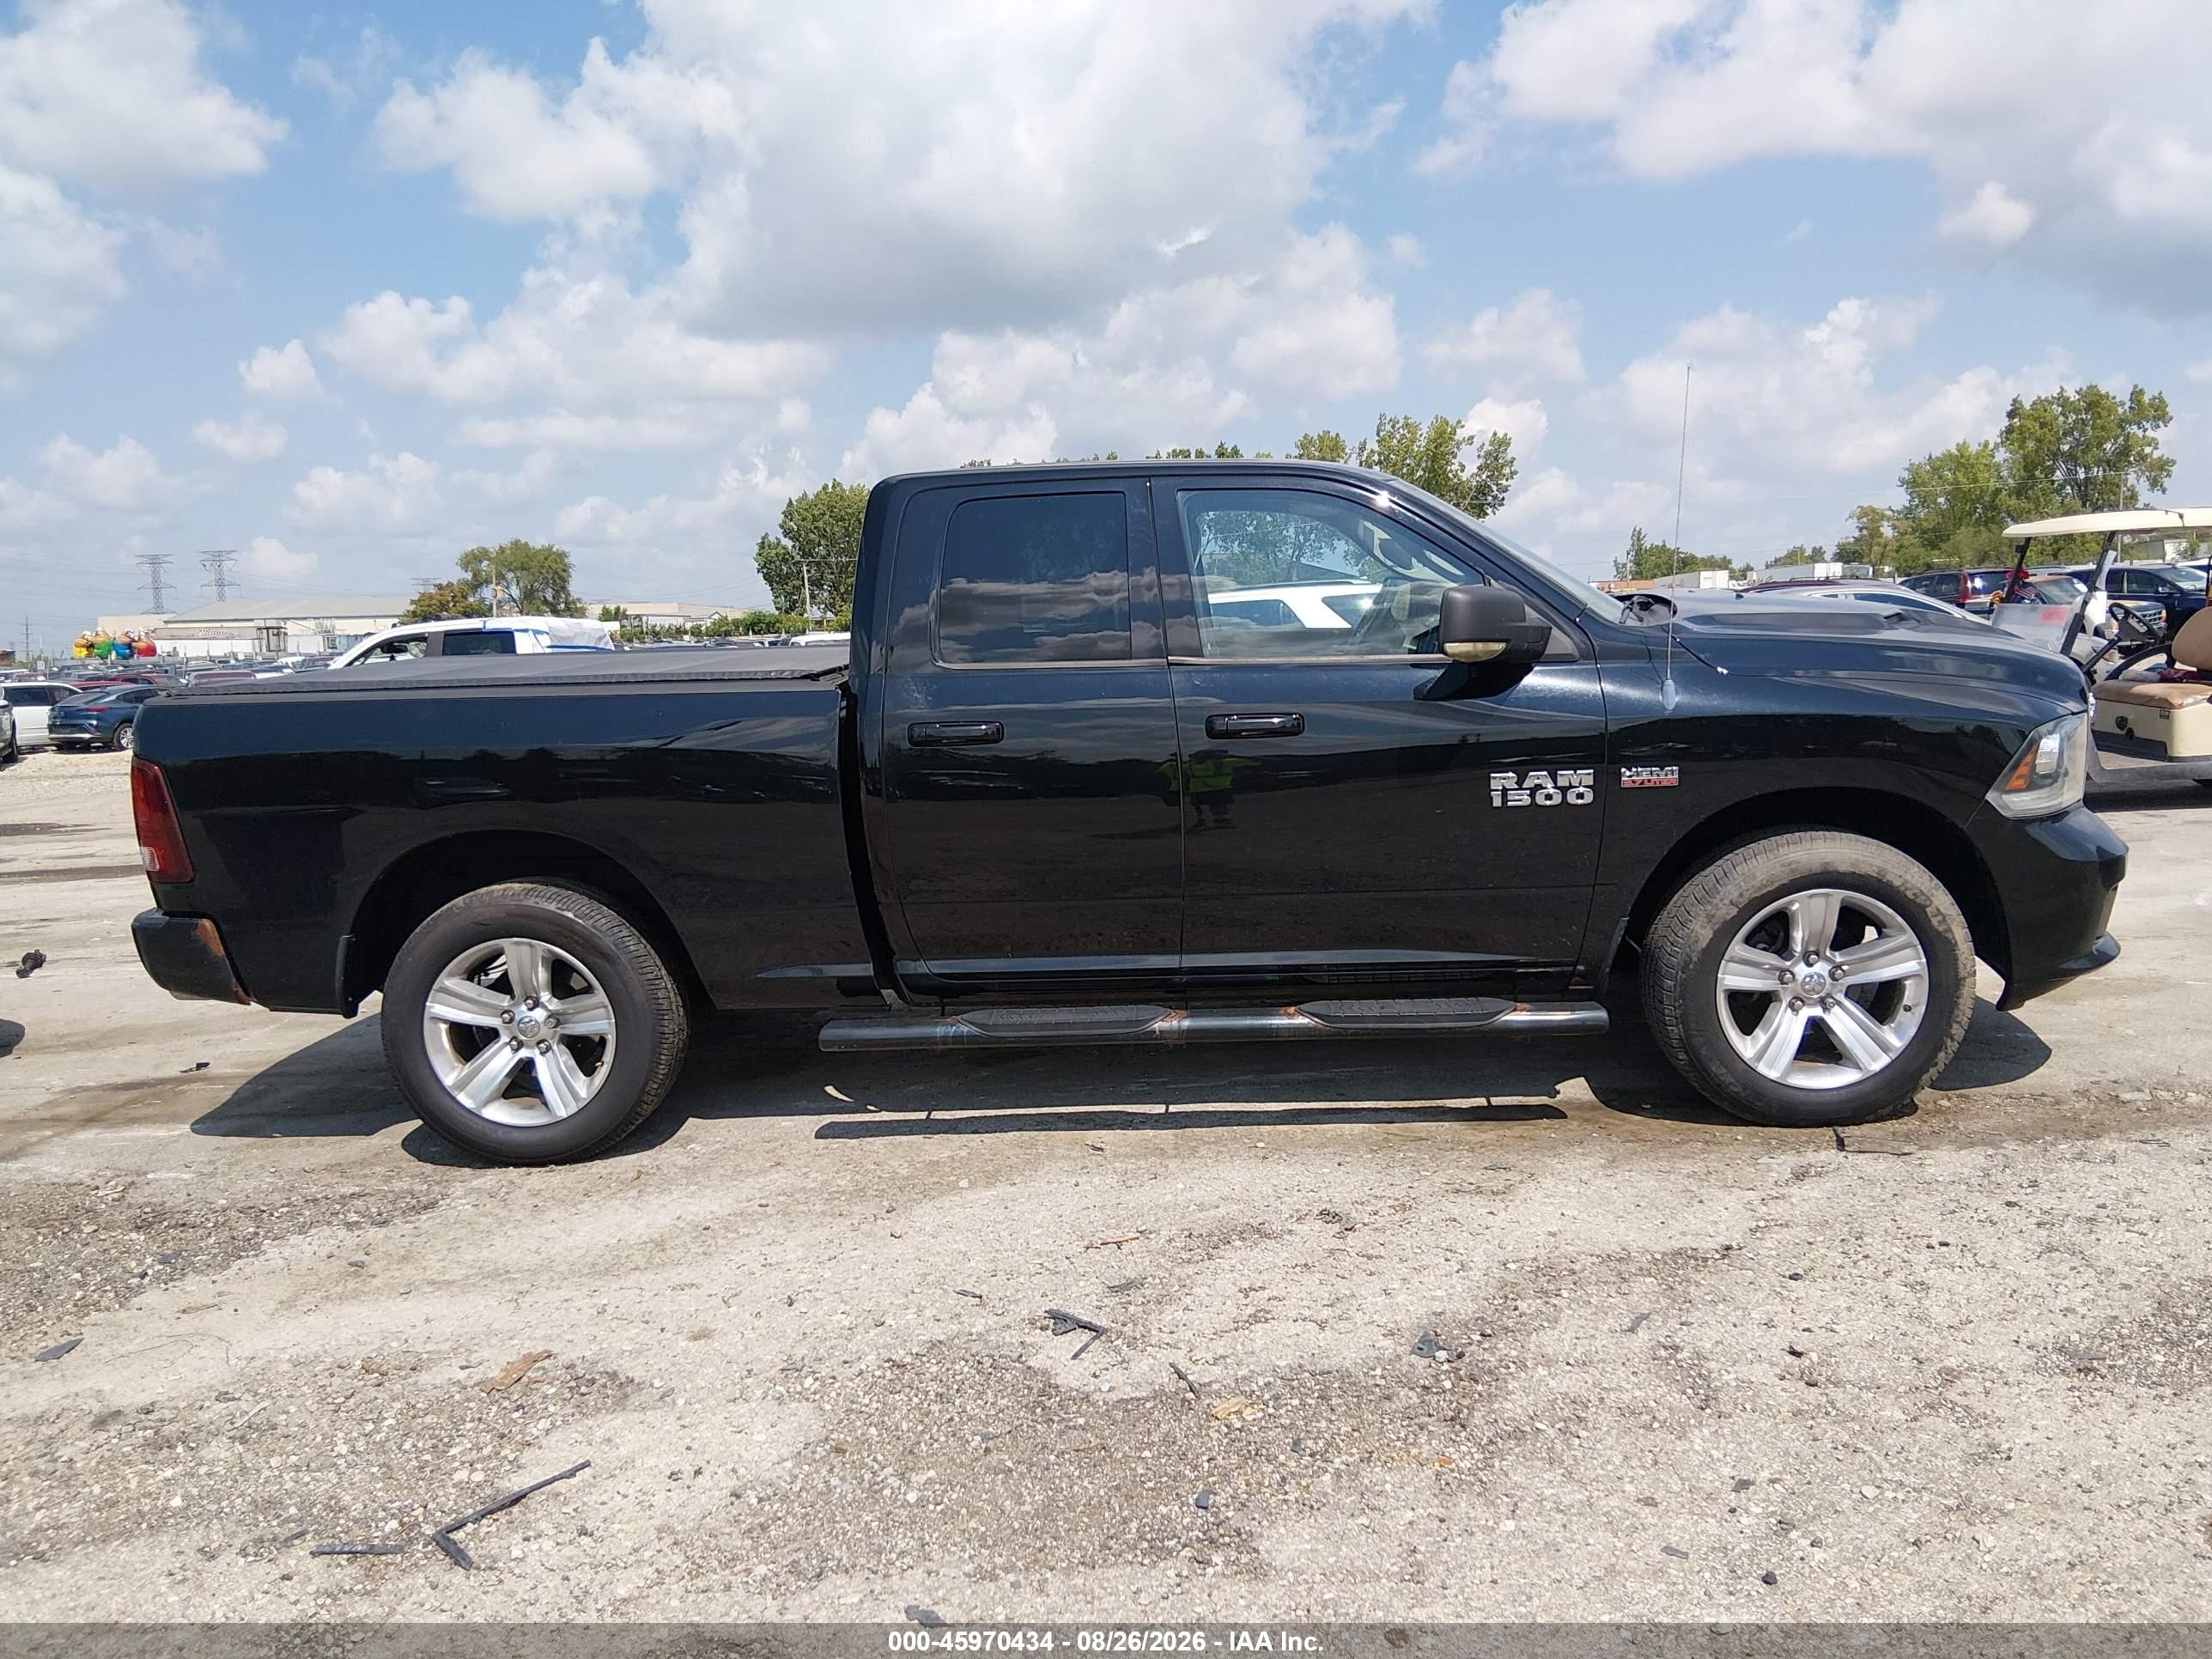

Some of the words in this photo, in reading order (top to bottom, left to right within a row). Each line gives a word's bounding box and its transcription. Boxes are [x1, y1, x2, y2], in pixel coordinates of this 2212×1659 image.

[1490, 769, 1594, 789] RAM
[1620, 765, 1679, 777] HEMI
[1491, 787, 1594, 807] 1500
